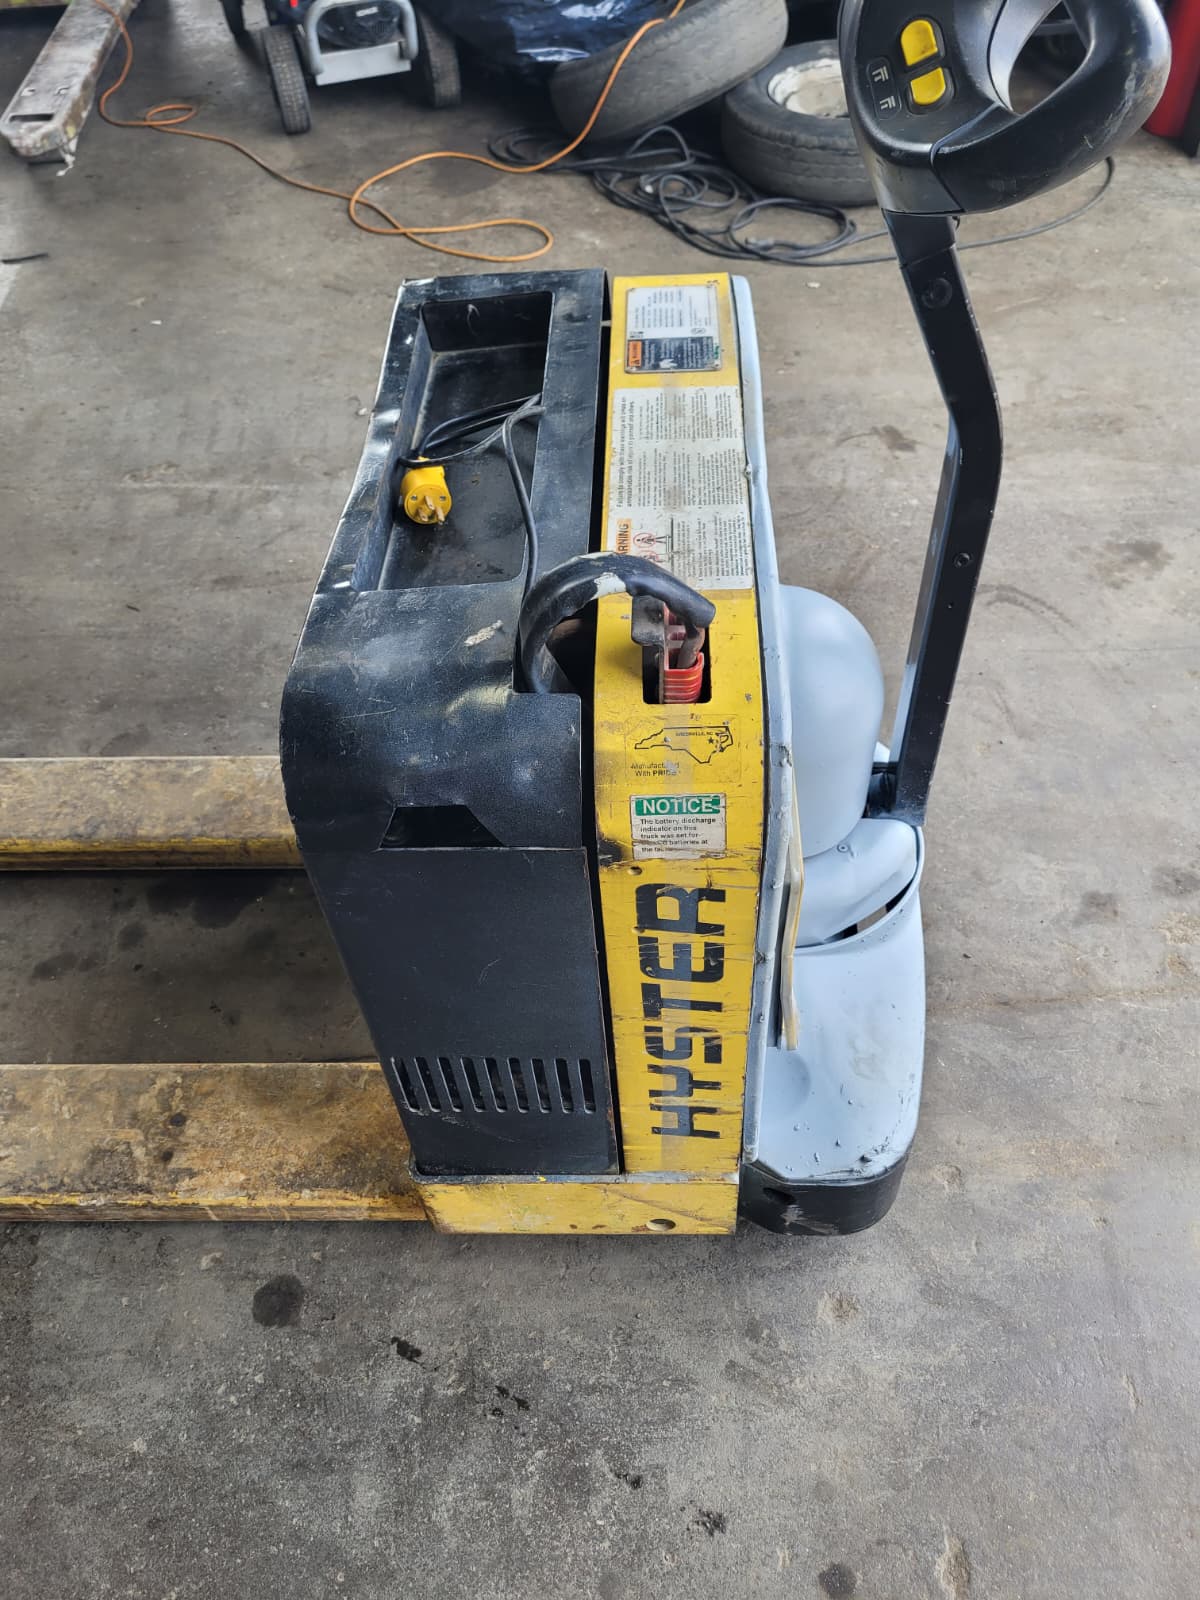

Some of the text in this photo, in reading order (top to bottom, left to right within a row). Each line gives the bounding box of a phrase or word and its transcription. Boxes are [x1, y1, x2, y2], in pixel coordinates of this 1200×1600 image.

[617, 523, 629, 554] RNING
[630, 762, 680, 770] Manufactd
[642, 798, 714, 814] NOTICE
[681, 817, 717, 825] discharge
[635, 883, 726, 1139] HYSTER
